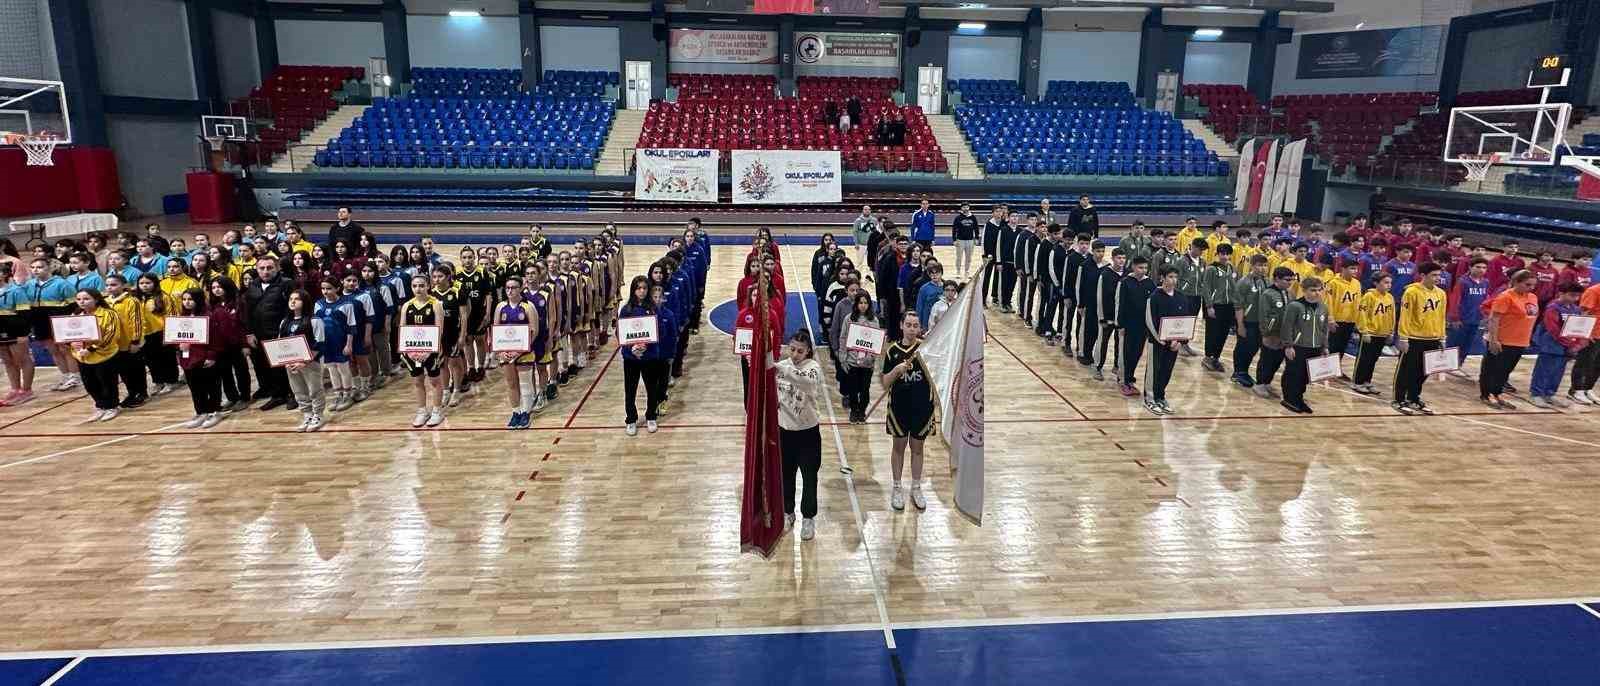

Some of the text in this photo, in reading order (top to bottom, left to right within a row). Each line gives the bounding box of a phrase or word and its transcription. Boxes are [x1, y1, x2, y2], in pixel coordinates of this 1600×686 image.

[644, 149, 667, 157] OKUL
[177, 331, 194, 339] BOLU
[626, 331, 650, 339] ANKARA
